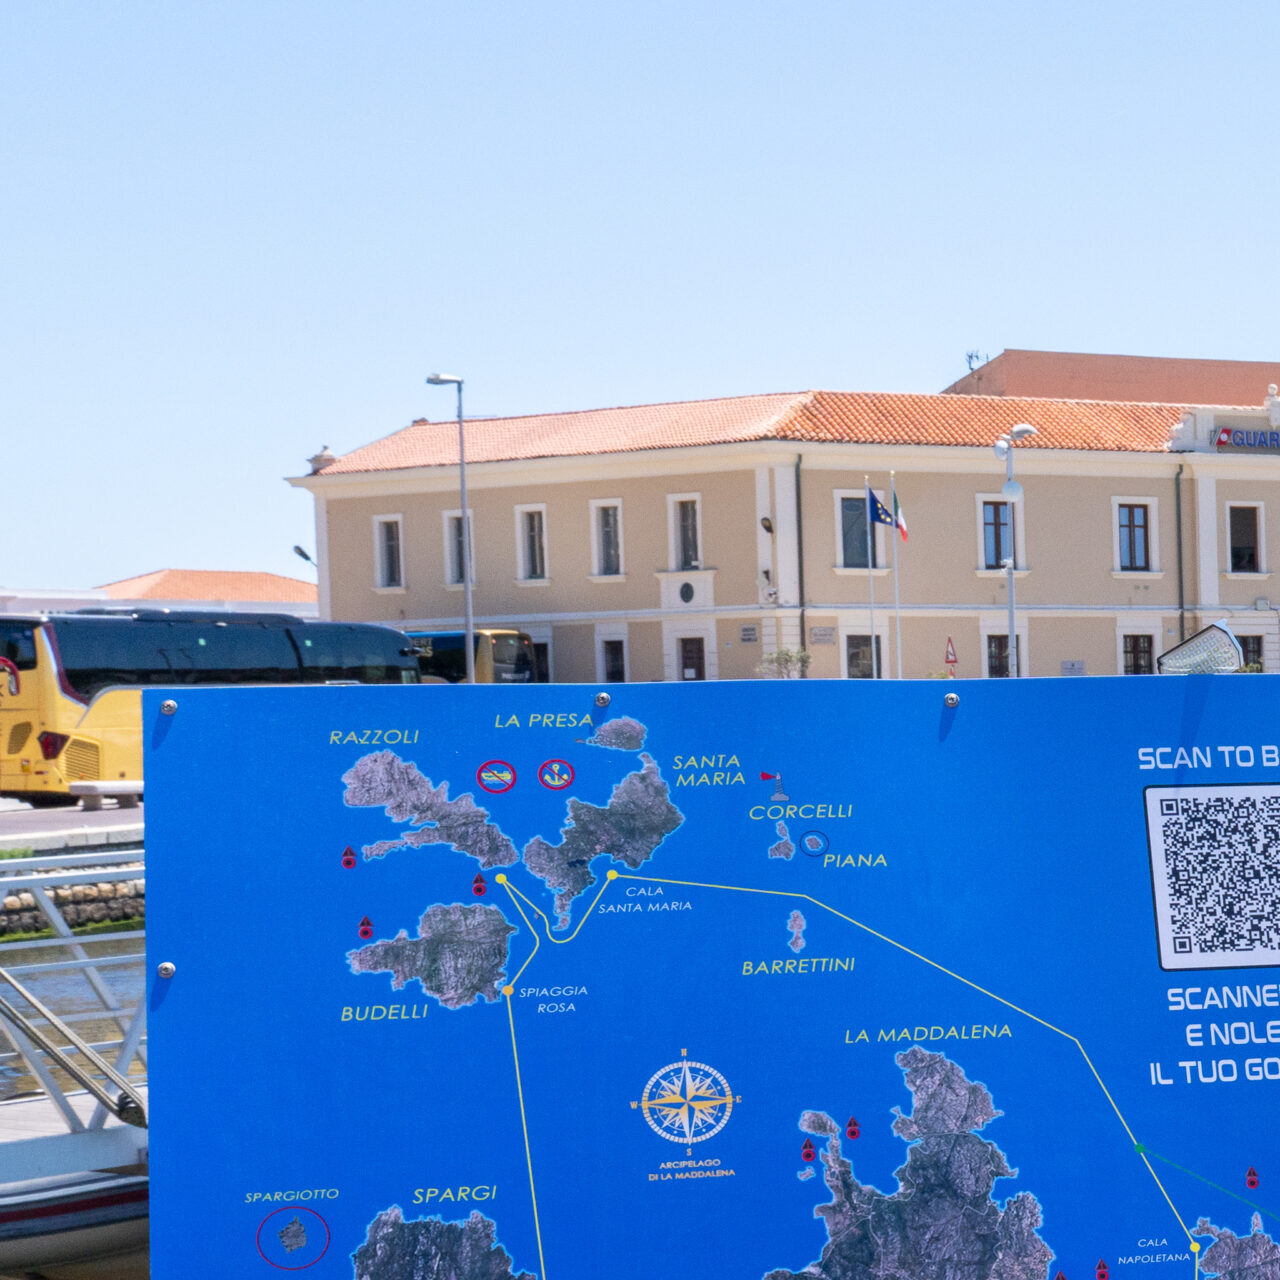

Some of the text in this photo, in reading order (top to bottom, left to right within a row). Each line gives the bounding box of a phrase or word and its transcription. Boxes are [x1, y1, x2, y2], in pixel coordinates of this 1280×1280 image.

[494, 712, 594, 728] LA PRESA
[329, 729, 419, 745] RAZZOLI
[672, 754, 741, 770] SANTA
[1137, 746, 1212, 770] SCAN
[1217, 745, 1255, 768] TO
[675, 771, 746, 787] MARIA
[749, 803, 853, 821] CORCELLI
[823, 853, 888, 868] PIANA
[625, 886, 664, 897] CALA
[598, 901, 693, 914] SANTA MARIA
[742, 957, 855, 976] BARRETTINI
[519, 985, 588, 998] SPIAGGIA
[340, 1003, 428, 1022] BUDELLI
[537, 1002, 576, 1014] ROSA
[844, 1024, 1013, 1044] LA MADDALENA
[1185, 1023, 1204, 1047] E
[1149, 1062, 1174, 1086] IL
[1178, 1059, 1238, 1084] TUO
[660, 1158, 721, 1170] ARCIPELAGO
[648, 1169, 735, 1182] DI LA MADDALENA
[244, 1188, 340, 1204] SPARGIOTTO
[412, 1184, 497, 1205] SPARGI
[1137, 1238, 1168, 1248] CALA
[1118, 1252, 1191, 1265] NAPOLETANA
